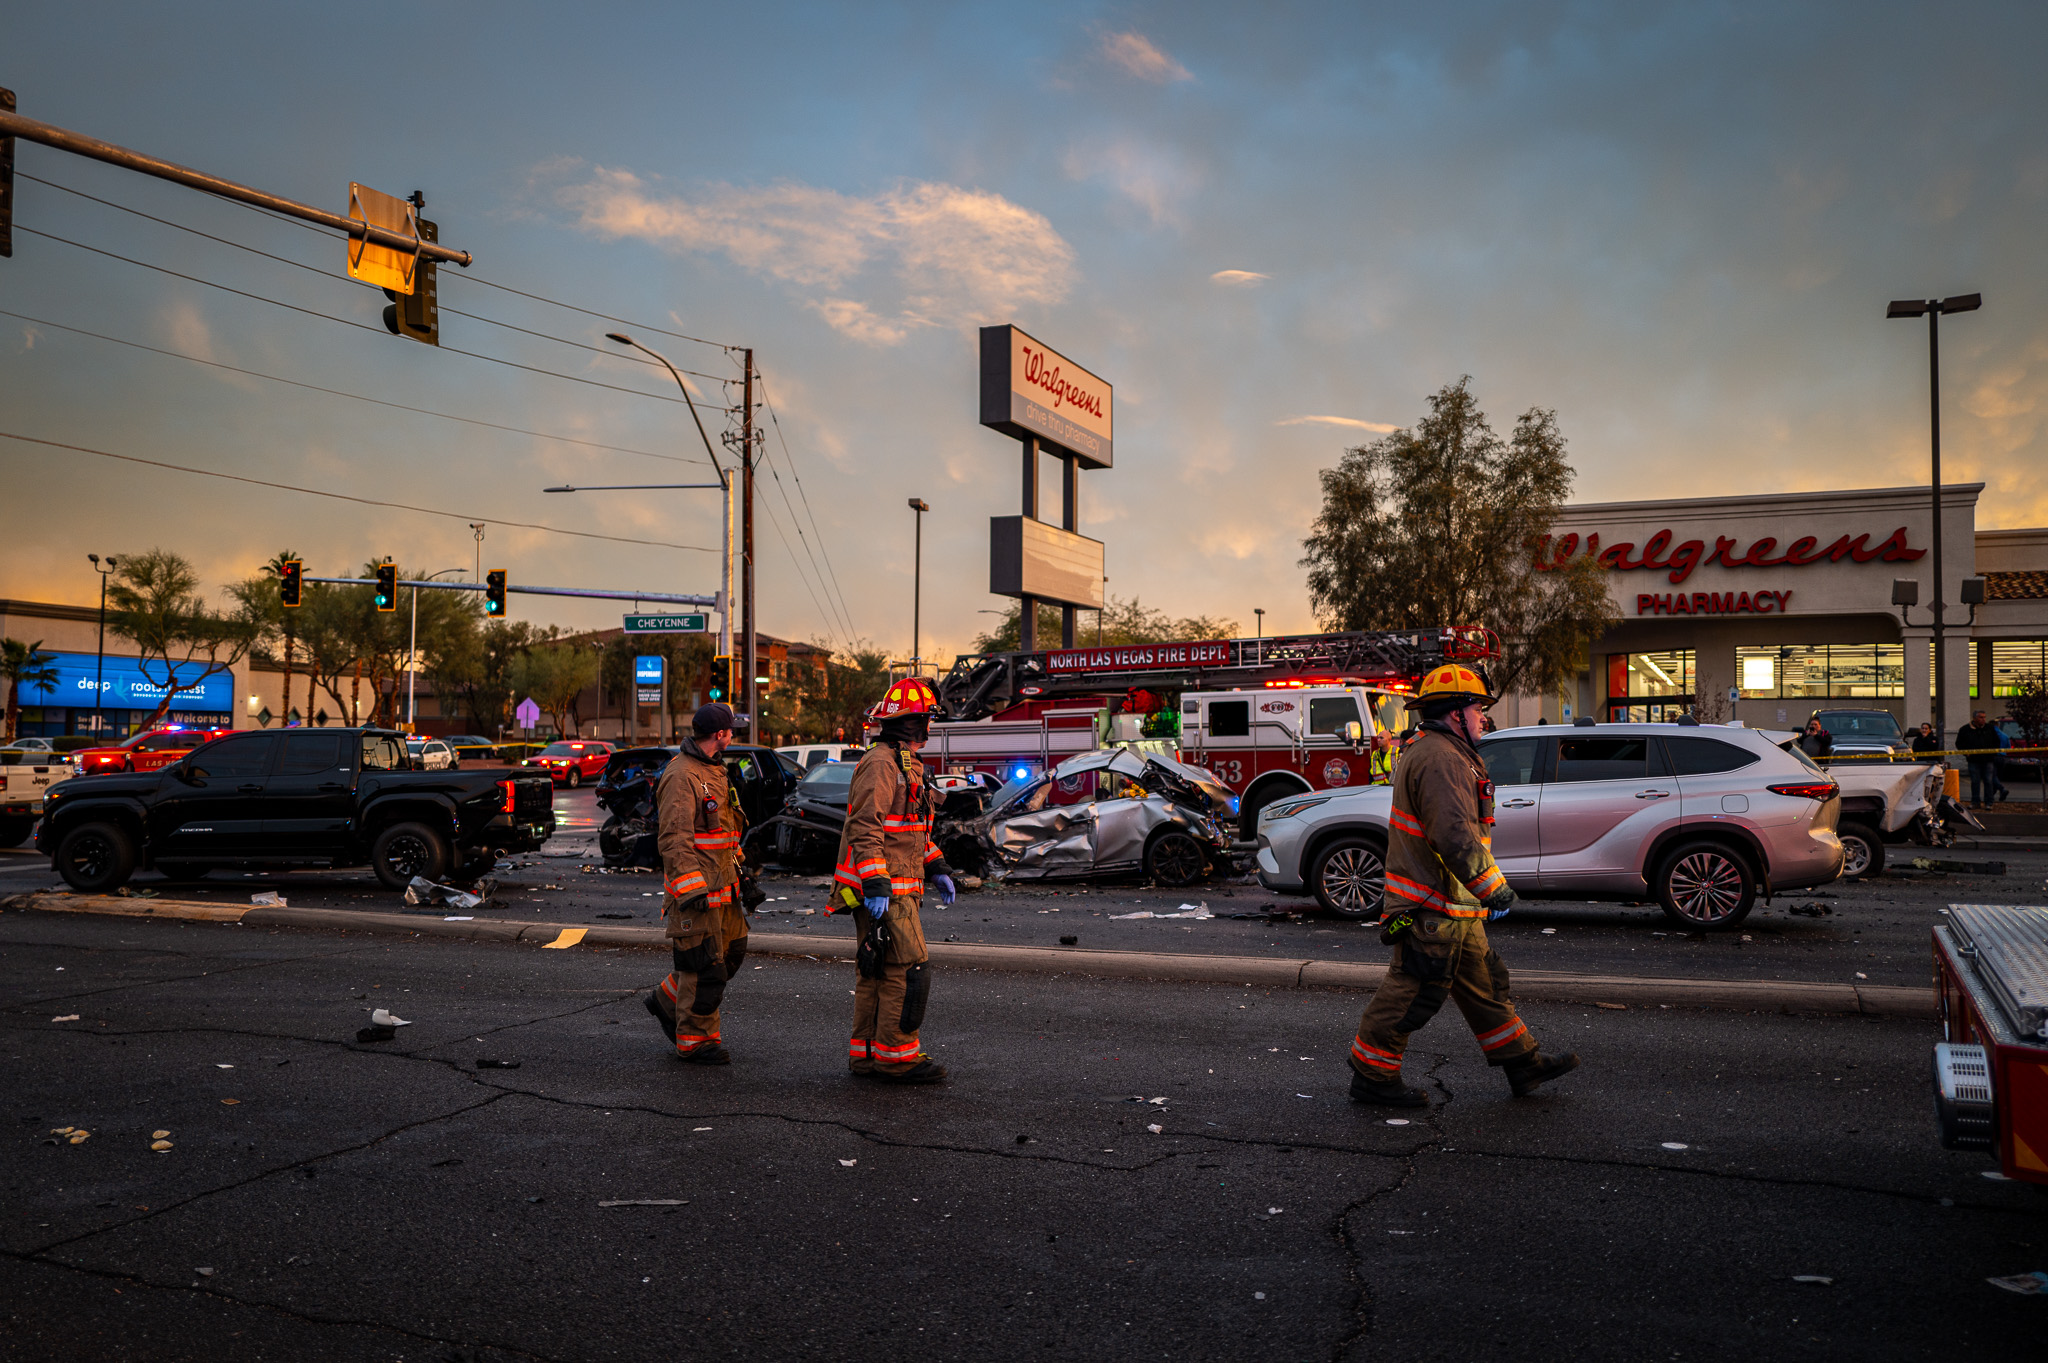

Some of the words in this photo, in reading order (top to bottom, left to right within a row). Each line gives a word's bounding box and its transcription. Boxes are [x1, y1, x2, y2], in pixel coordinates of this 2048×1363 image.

[1022, 346, 1103, 418] Walgreens
[1026, 403, 1047, 426] drive
[1048, 412, 1063, 434] thru
[1065, 423, 1100, 455] pharmacy
[1637, 590, 1792, 615] PHARMACY
[637, 618, 690, 628] CHEYENNE
[1050, 653, 1087, 669] NORTH
[1090, 651, 1111, 667] LAS
[1114, 649, 1153, 665] VEGAS
[1158, 647, 1186, 663] FIRE
[1190, 645, 1226, 661] DEPT.
[173, 712, 217, 723] Welcome
[220, 714, 230, 724] to
[32, 775, 50, 786] Jeep
[1213, 759, 1243, 783] 53
